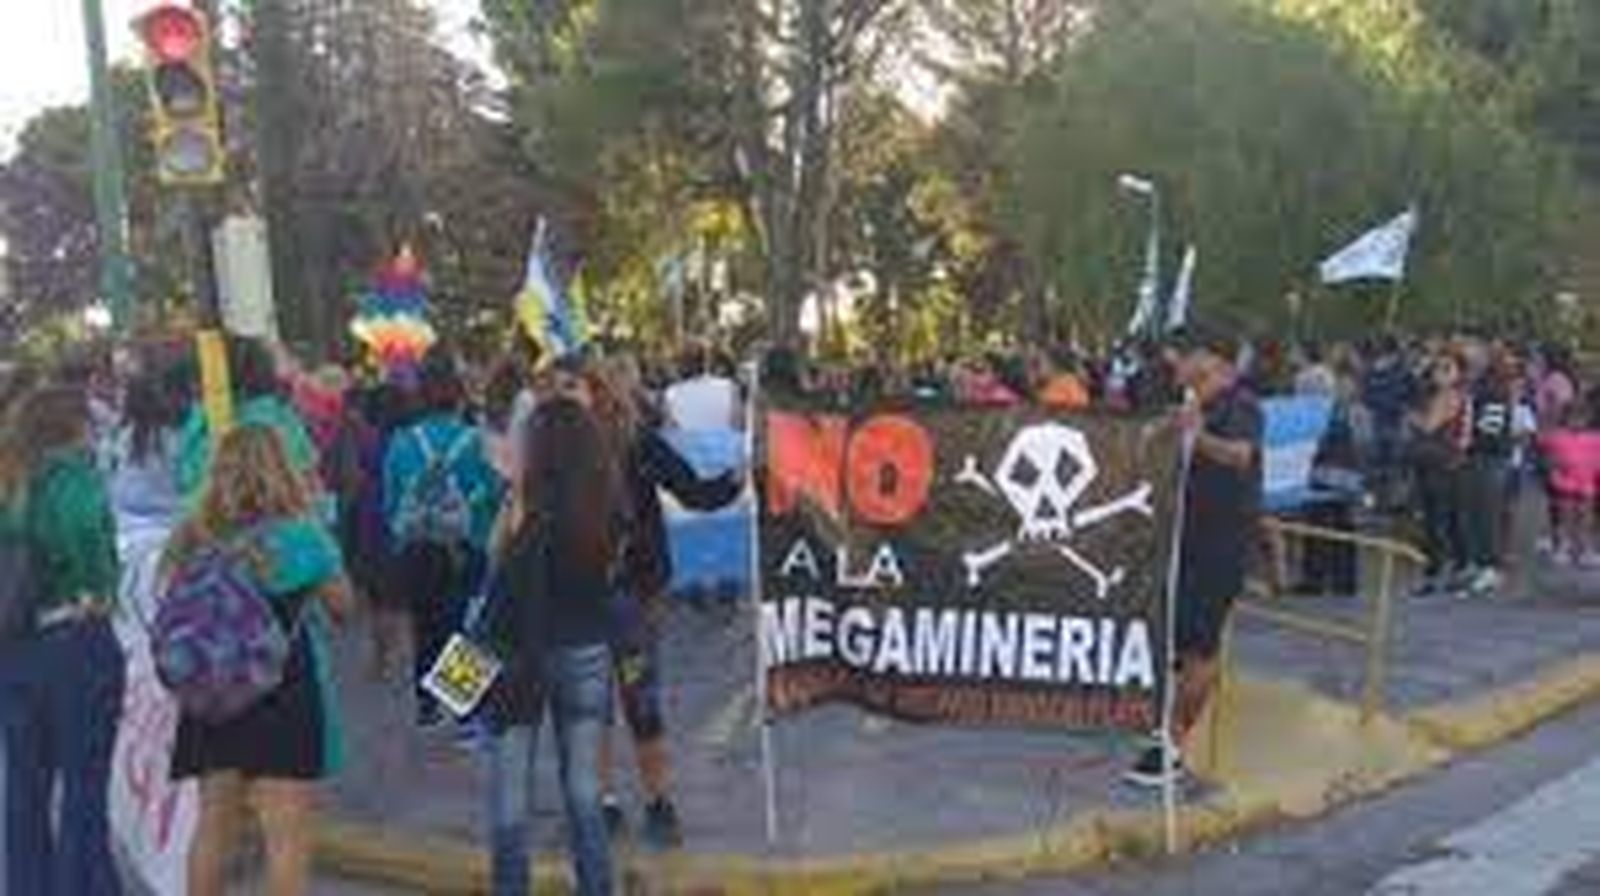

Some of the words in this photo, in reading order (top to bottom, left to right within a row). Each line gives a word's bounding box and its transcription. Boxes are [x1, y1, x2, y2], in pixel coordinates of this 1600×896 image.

[767, 411, 934, 526] NO
[780, 538, 819, 579] A
[835, 543, 904, 587] LA
[760, 597, 1156, 688] MEGAMINERIA
